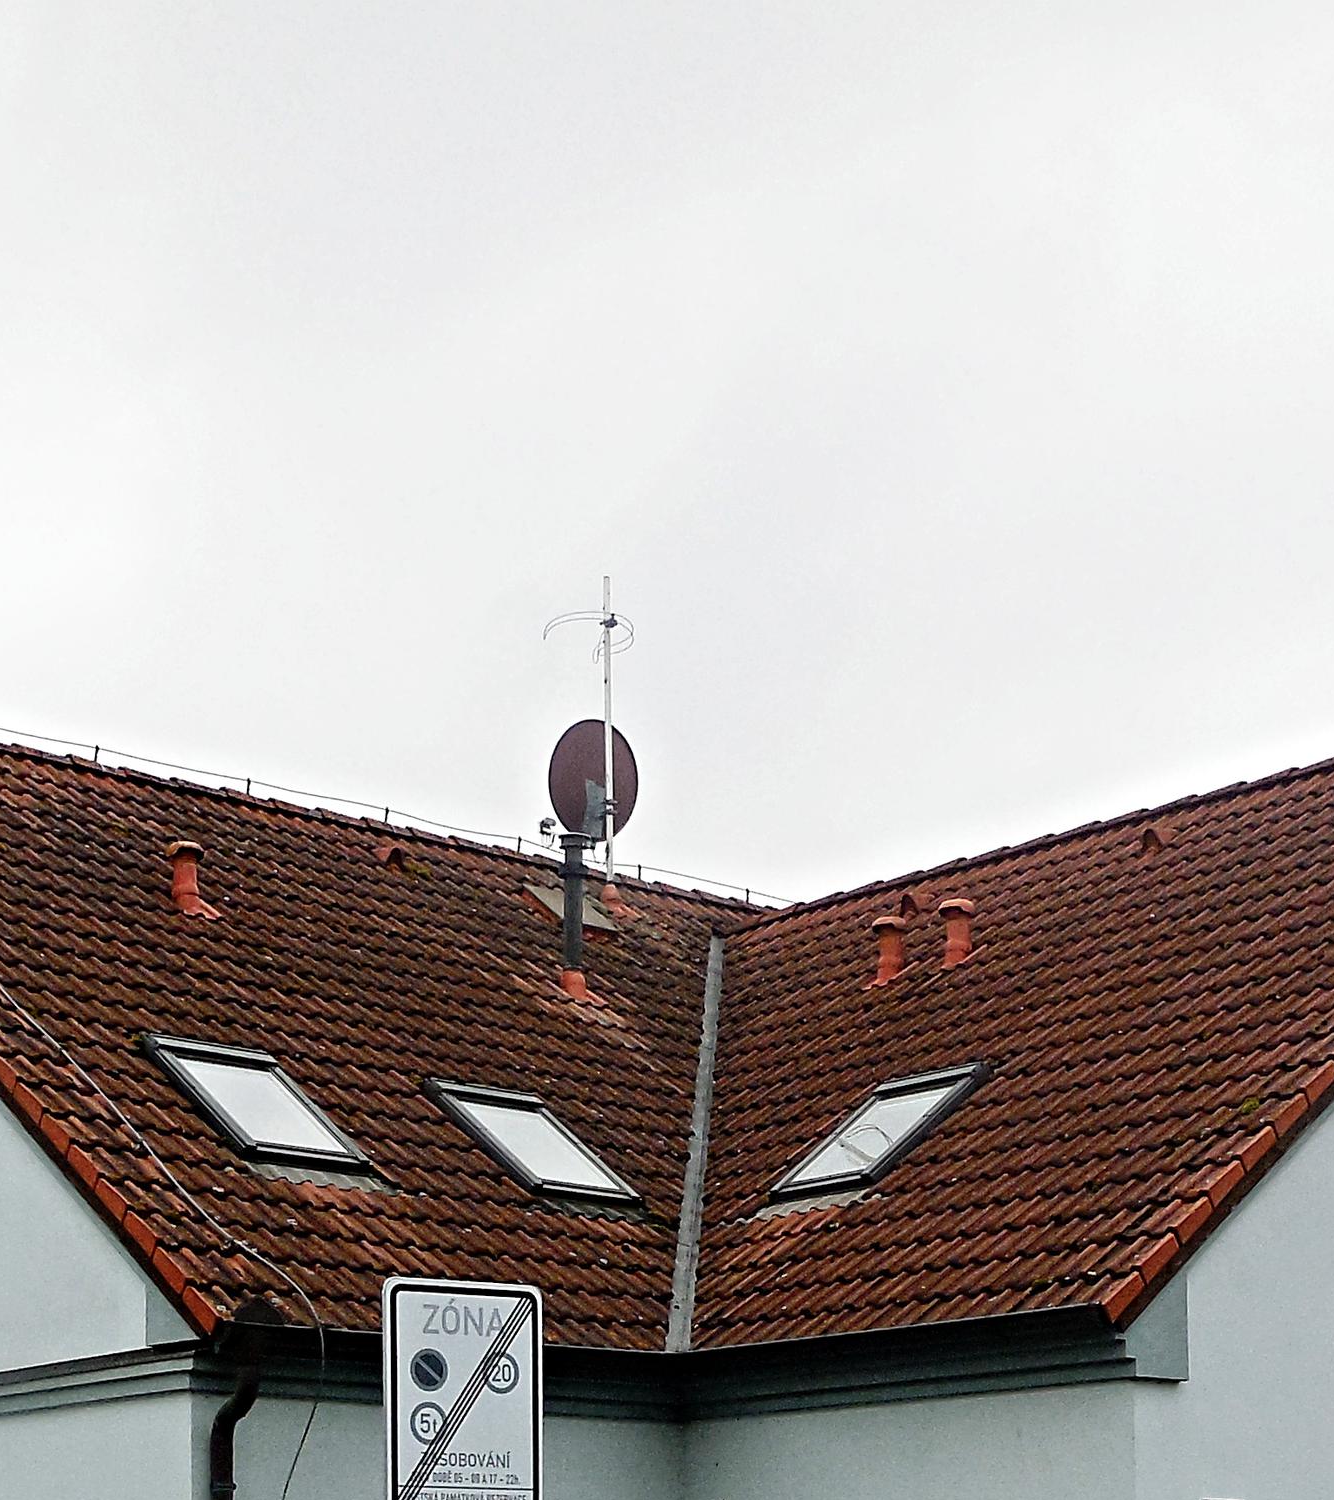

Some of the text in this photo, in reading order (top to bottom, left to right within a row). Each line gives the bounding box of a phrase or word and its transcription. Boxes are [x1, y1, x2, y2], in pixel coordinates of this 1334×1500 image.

[422, 1298, 505, 1338] ZÓNA
[491, 1363, 512, 1383] 20
[419, 1412, 439, 1434] 5t
[420, 1450, 511, 1469] SOBOVÁNÍ
